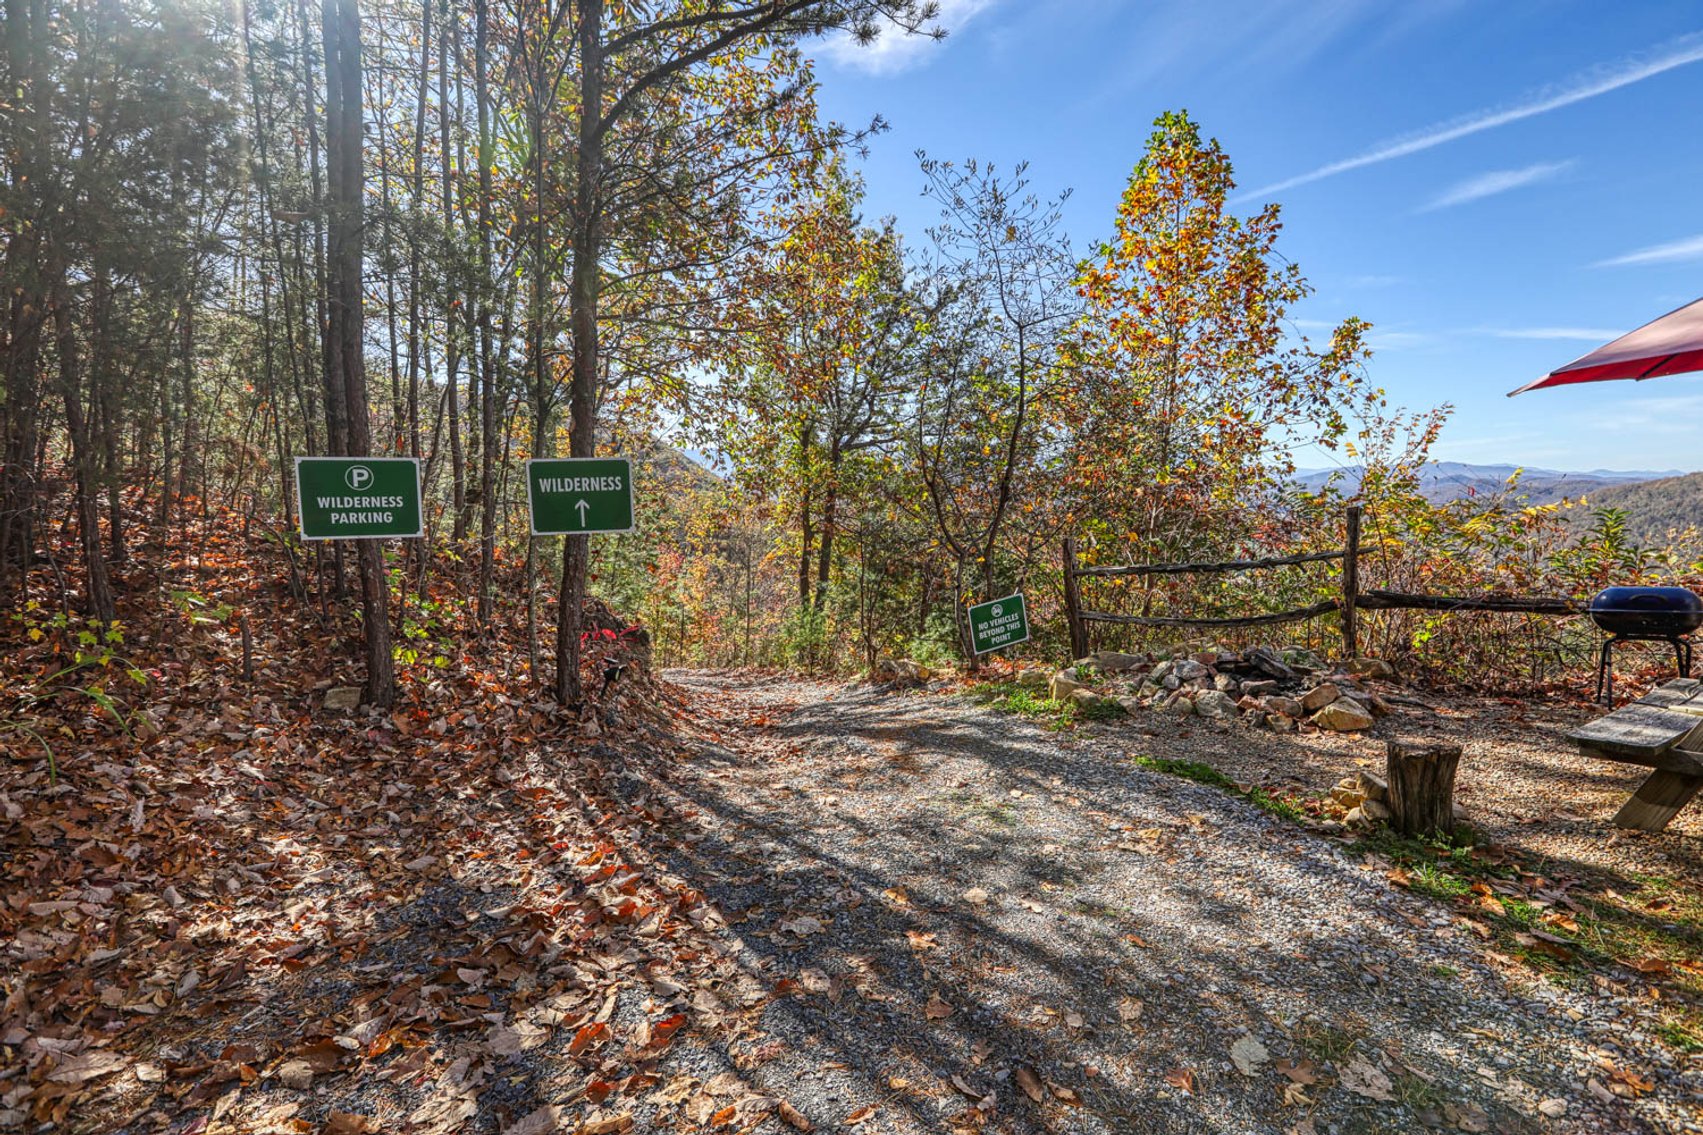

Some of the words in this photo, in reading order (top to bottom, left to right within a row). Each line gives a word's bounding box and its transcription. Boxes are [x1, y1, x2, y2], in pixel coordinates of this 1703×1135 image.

[352, 468, 369, 487] P
[538, 476, 622, 493] WILDERNESS
[317, 496, 404, 508] WILDERNESS
[331, 511, 393, 524] PARKING
[978, 622, 989, 631] NO
[989, 612, 1019, 627] VEHICLES
[979, 625, 1005, 640] BEYOND
[1006, 621, 1021, 631] THIS
[991, 632, 1011, 645] POINT
